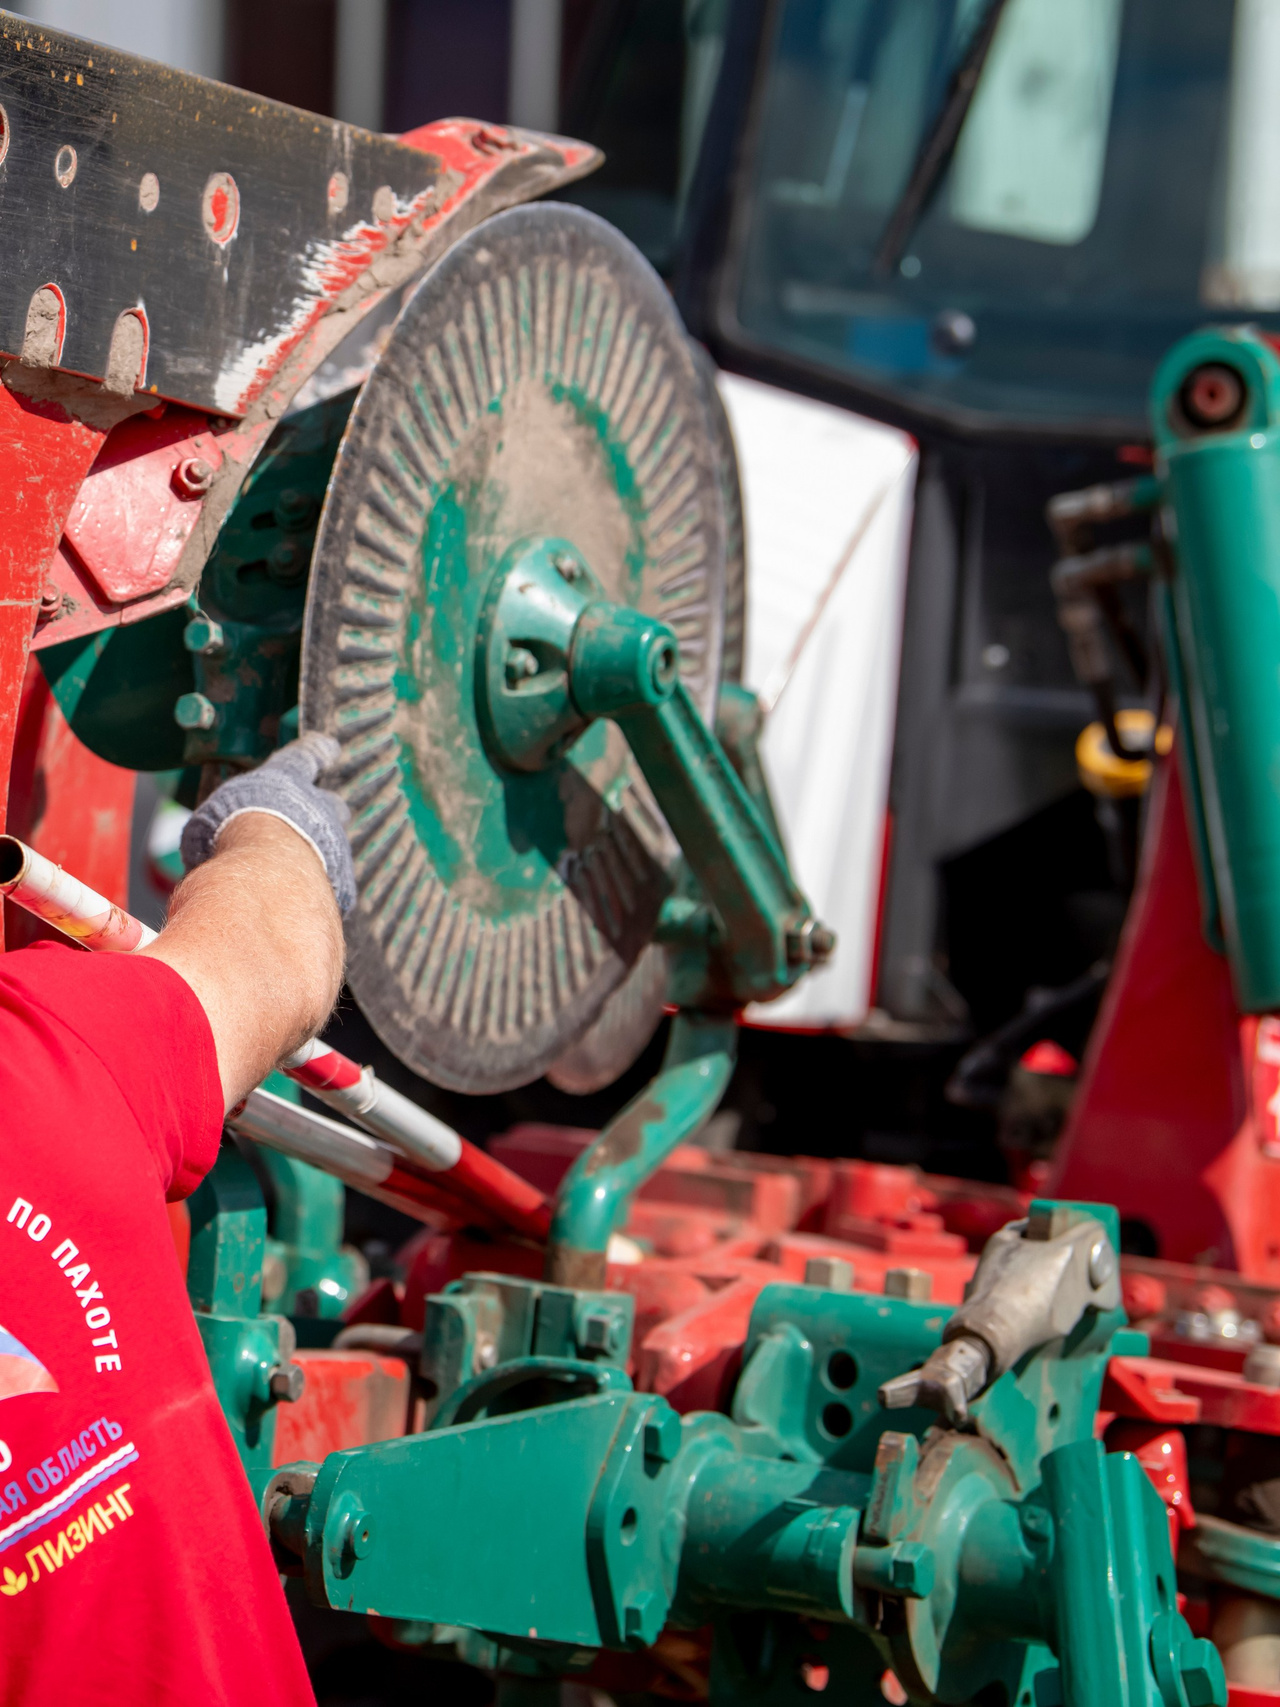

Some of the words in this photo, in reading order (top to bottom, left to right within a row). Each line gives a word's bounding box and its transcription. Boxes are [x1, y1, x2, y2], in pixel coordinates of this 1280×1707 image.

[6, 1197, 52, 1242] ПО
[51, 1238, 122, 1373] ПАХОТЕ
[26, 1417, 123, 1494] ОБЛАСТЬ
